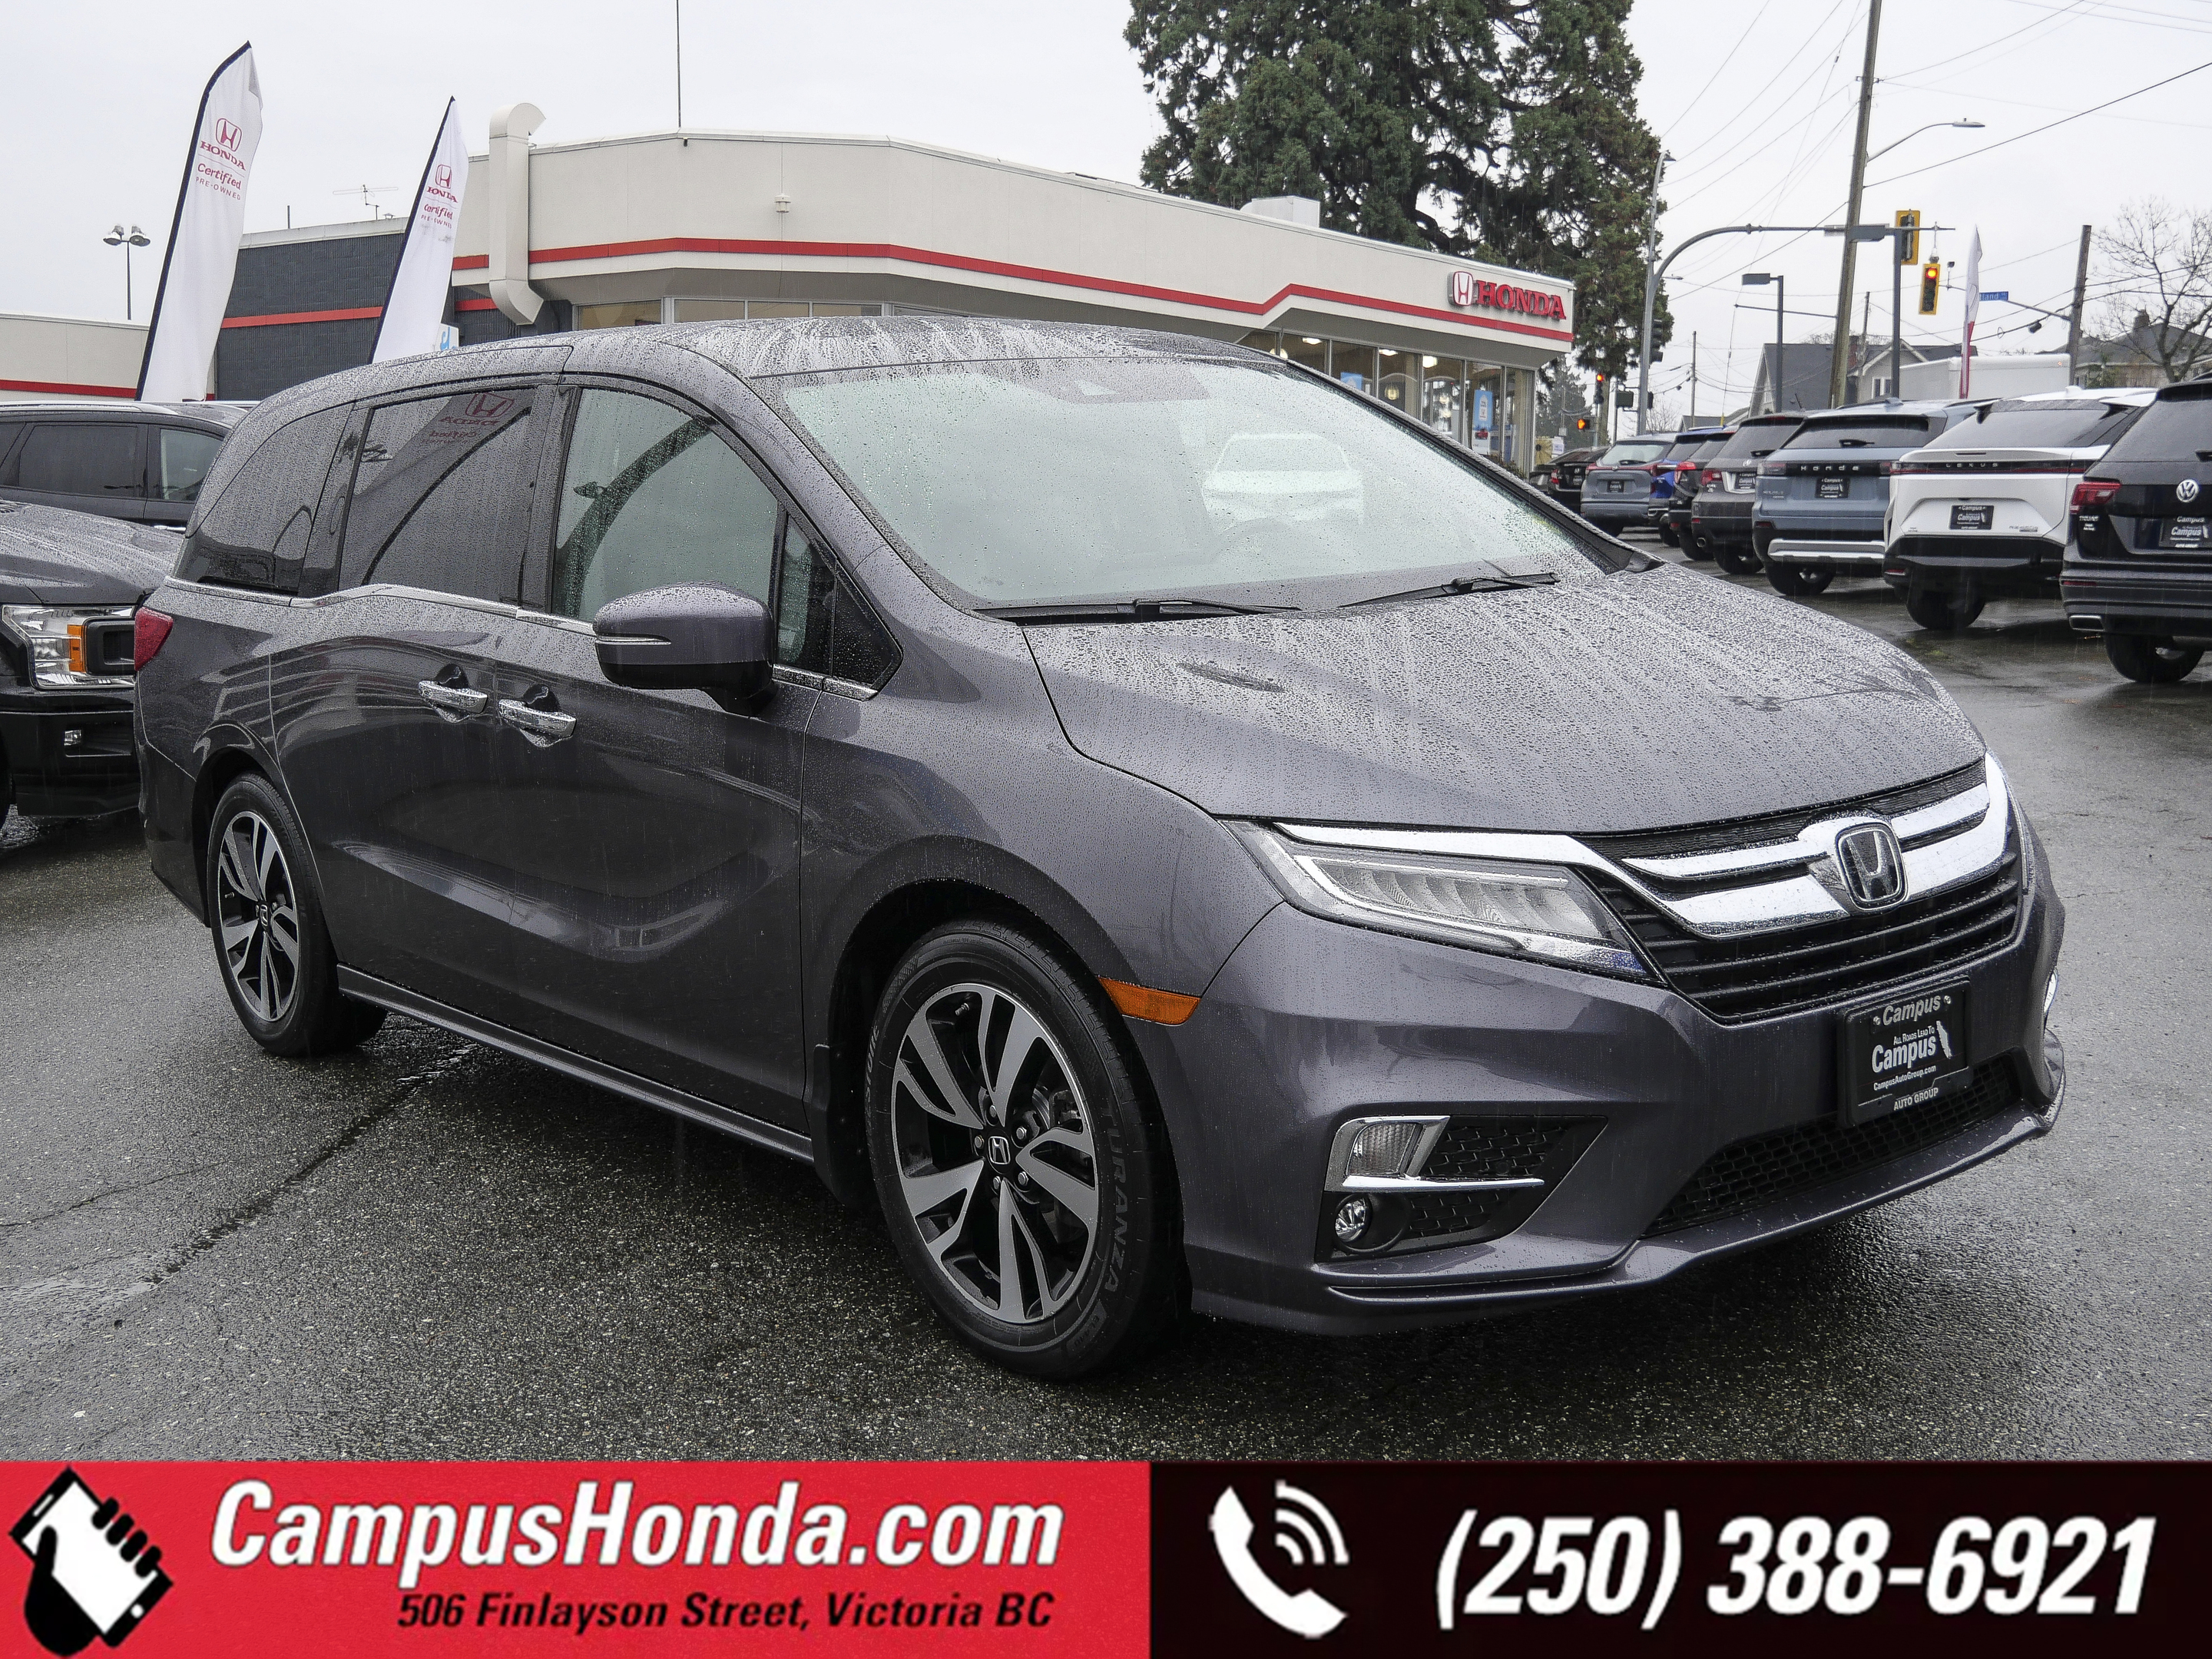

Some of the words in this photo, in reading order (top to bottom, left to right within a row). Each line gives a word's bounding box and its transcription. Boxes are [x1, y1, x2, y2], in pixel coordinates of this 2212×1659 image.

[200, 141, 246, 171] HONDA
[196, 177, 241, 200] PRE-OWNED
[198, 164, 242, 190] Certified
[1476, 280, 1567, 320] HONDA
[2171, 526, 2201, 537] Campus
[1883, 995, 1942, 1025] Campus
[1872, 1036, 1936, 1073] Campus
[1873, 1065, 1936, 1091] CampusAutoGroup.com
[1893, 1096, 1912, 1111] AUTO
[1914, 1087, 1939, 1105] GROUP
[1101, 1107, 1128, 1293] TURANZA
